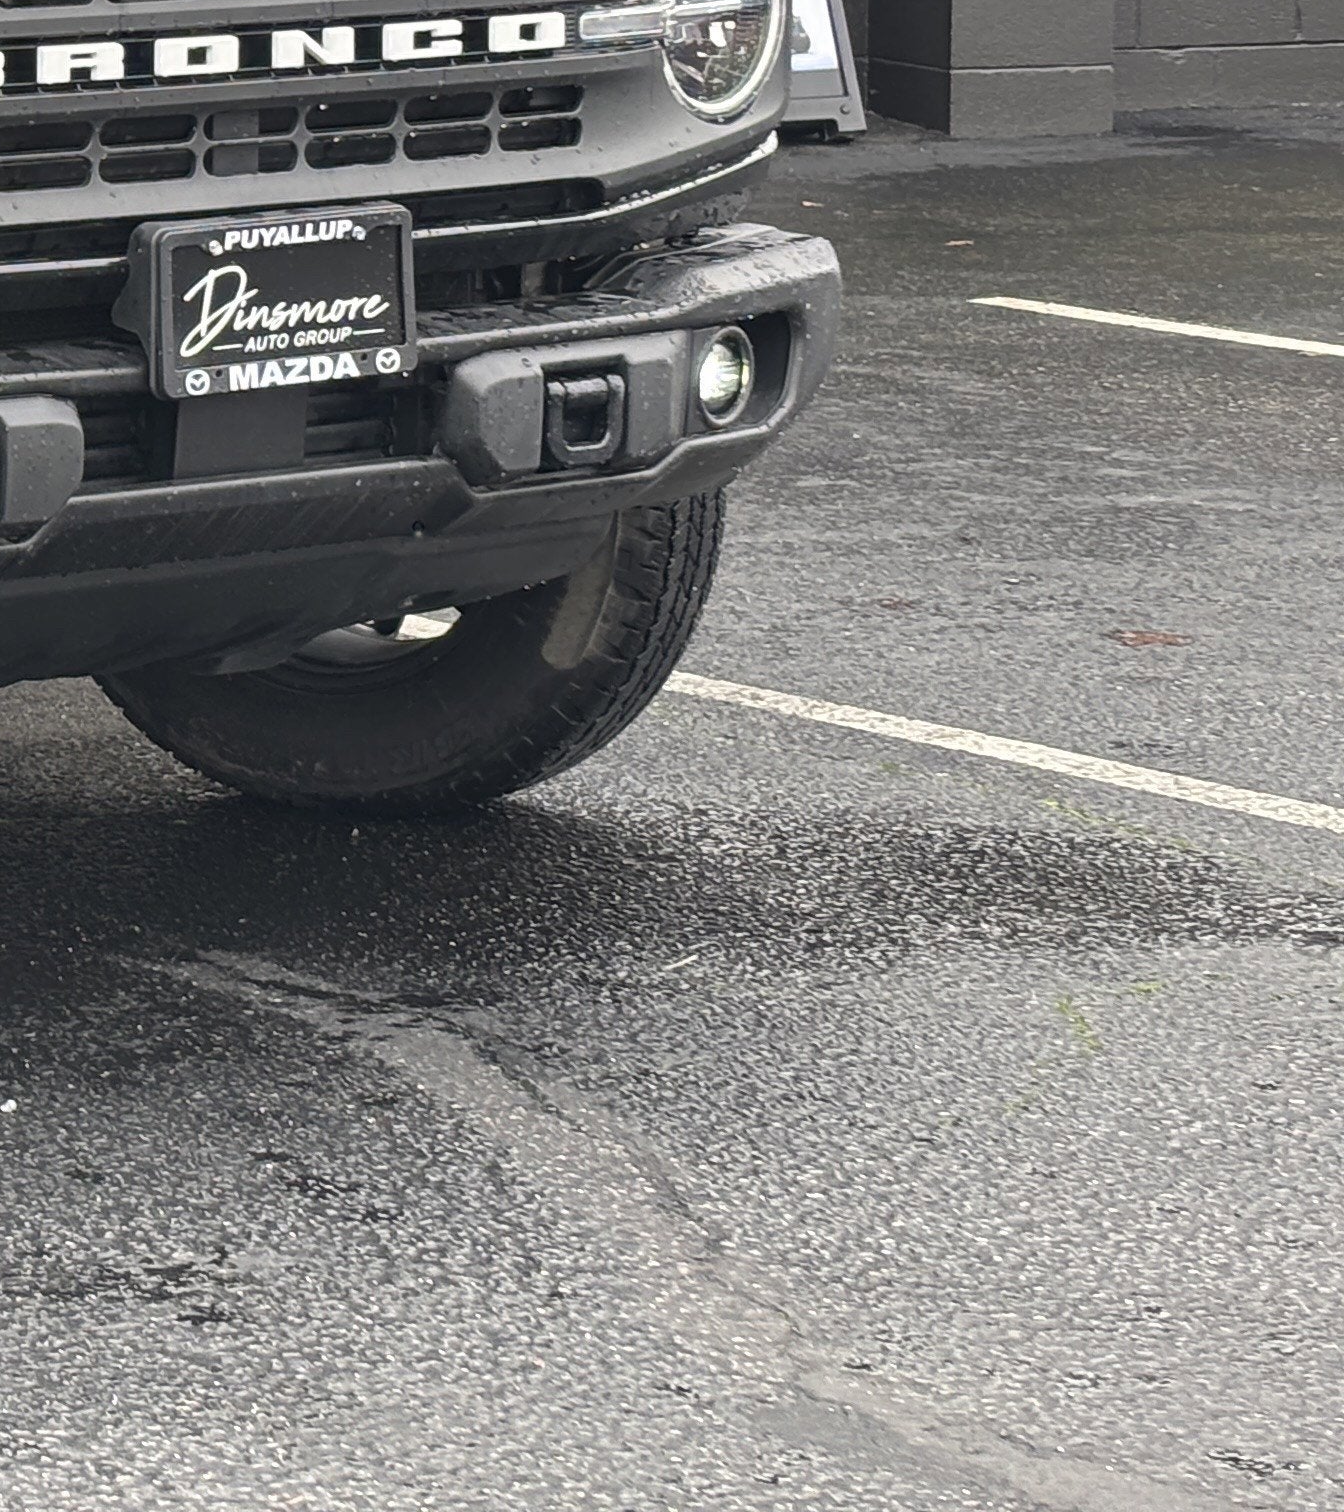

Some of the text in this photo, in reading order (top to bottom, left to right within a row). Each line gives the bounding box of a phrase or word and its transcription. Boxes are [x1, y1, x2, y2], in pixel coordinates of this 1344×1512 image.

[224, 219, 353, 251] PUYALLUP
[179, 265, 390, 358] Dinsmore
[243, 326, 353, 353] AUTO GROUP
[229, 352, 361, 392] MAZDA
